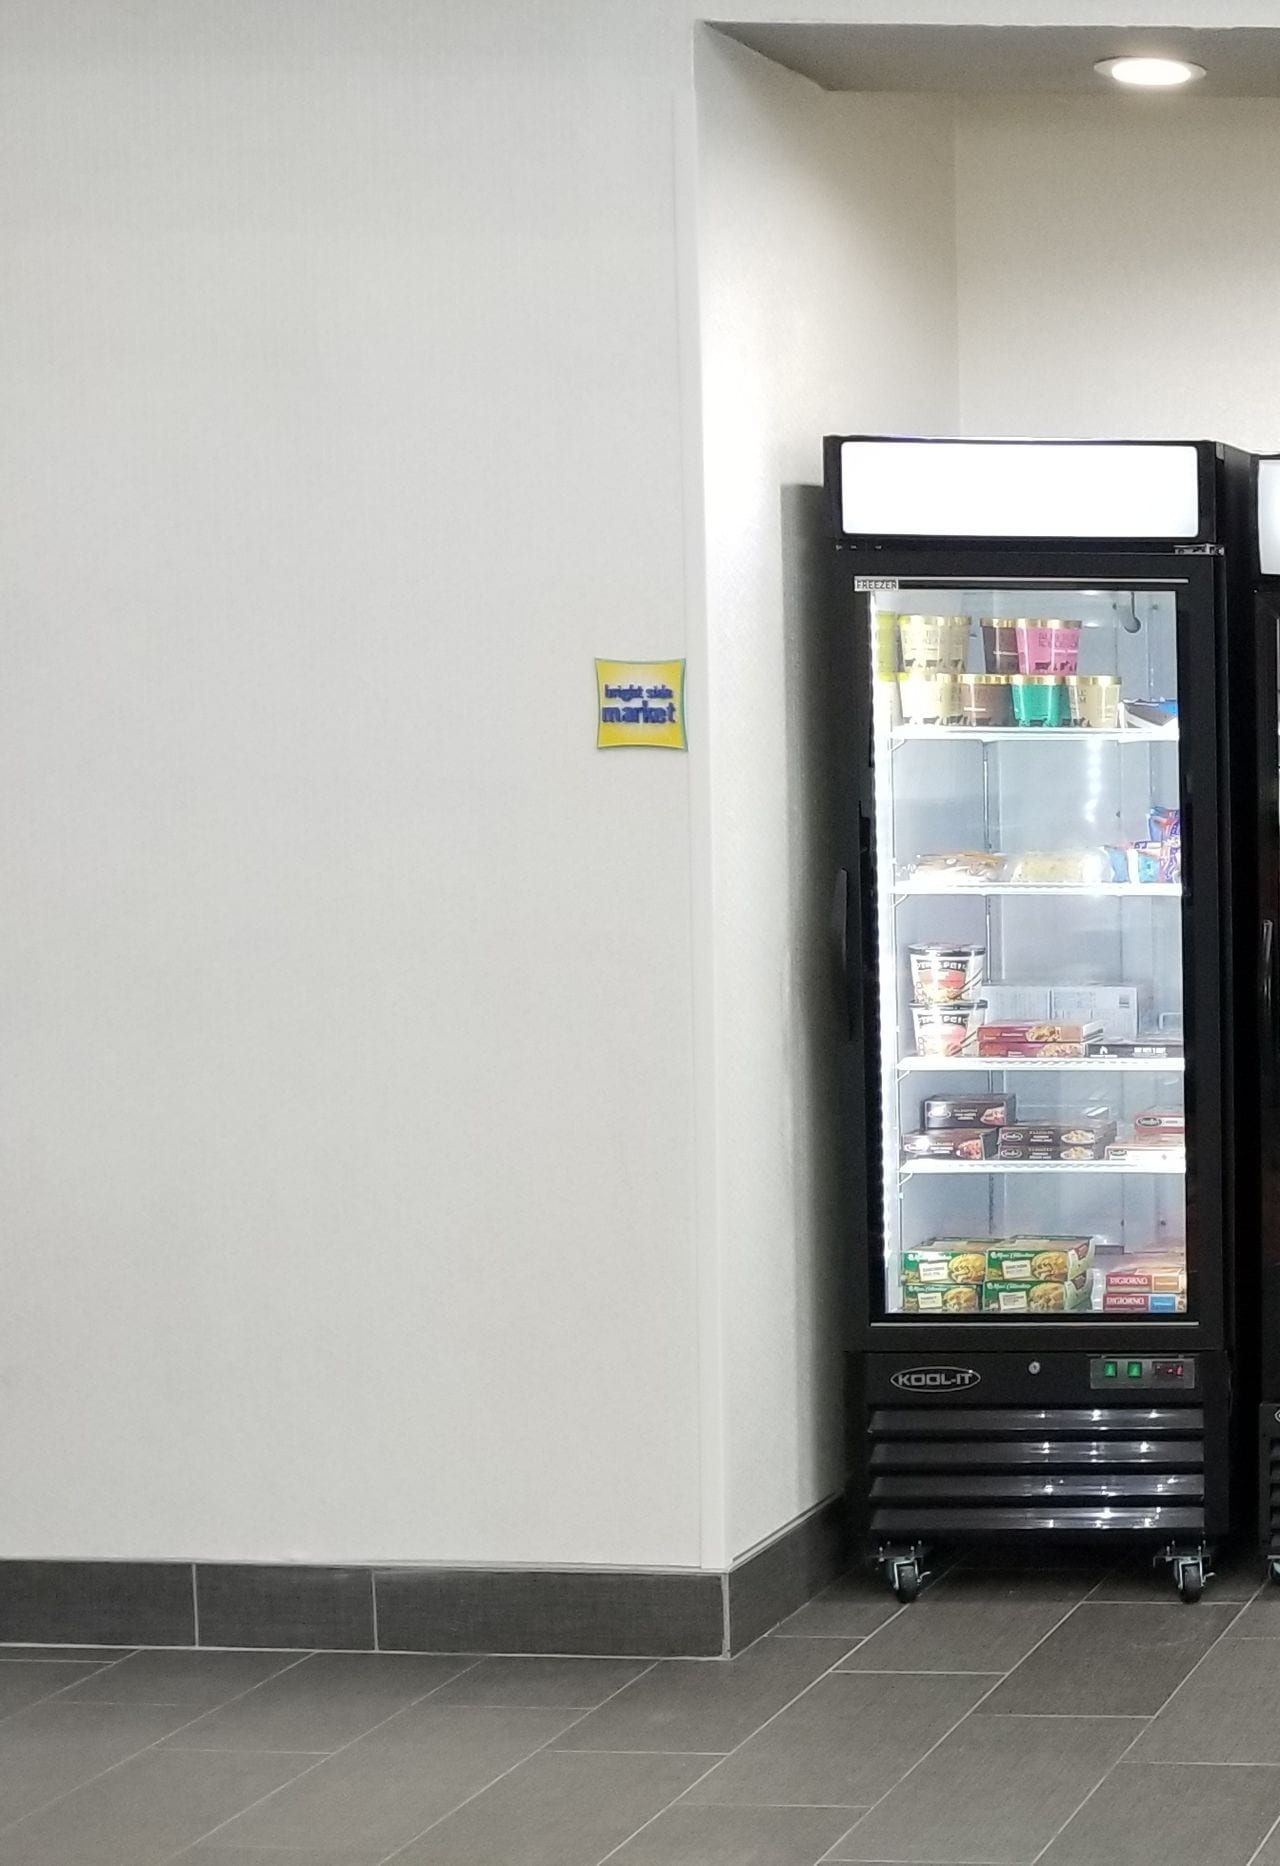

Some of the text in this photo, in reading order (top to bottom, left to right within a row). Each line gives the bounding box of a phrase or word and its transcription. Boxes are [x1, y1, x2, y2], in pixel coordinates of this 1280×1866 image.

[855, 579, 898, 590] FREEZER
[604, 684, 673, 702] bright side
[601, 700, 676, 724] market
[898, 1372, 973, 1388] KOOL-IT
